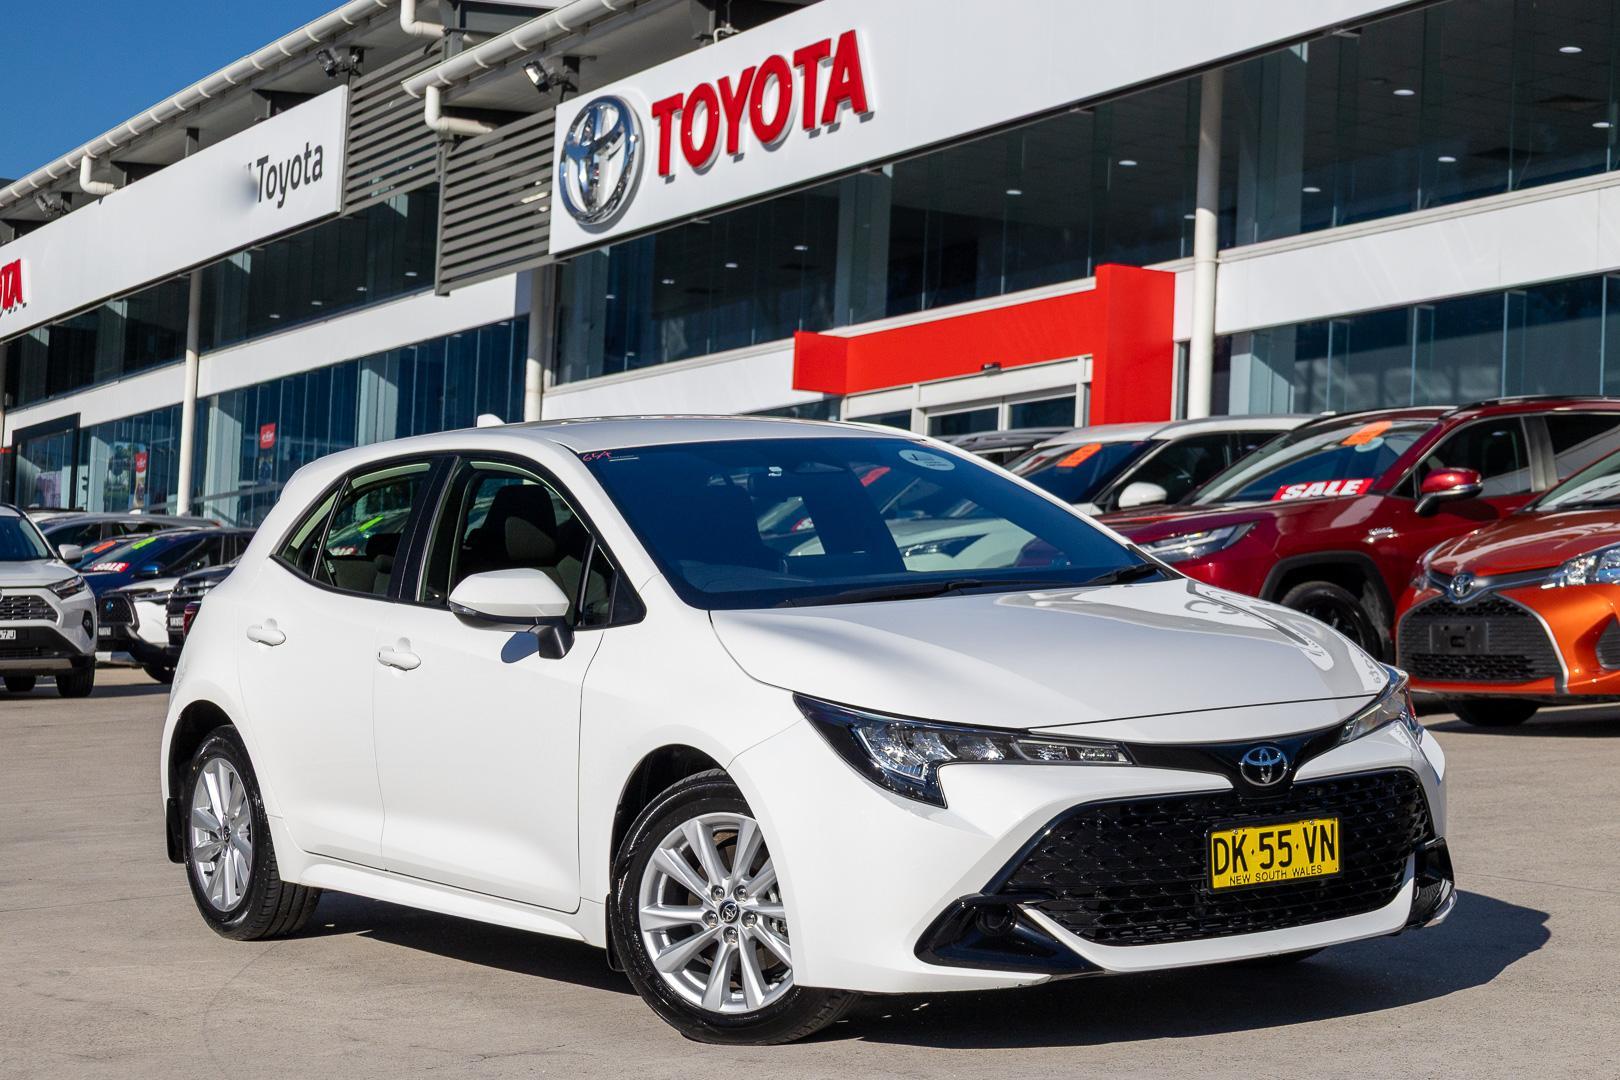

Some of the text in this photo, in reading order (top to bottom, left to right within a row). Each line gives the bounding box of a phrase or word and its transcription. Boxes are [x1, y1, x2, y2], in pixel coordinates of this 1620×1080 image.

[651, 30, 869, 177] TOYOTA
[257, 142, 323, 209] Toyota
[0, 258, 23, 312] TA
[1281, 479, 1363, 500] SALE
[1229, 864, 1323, 886] NEW SOUTH WALES
